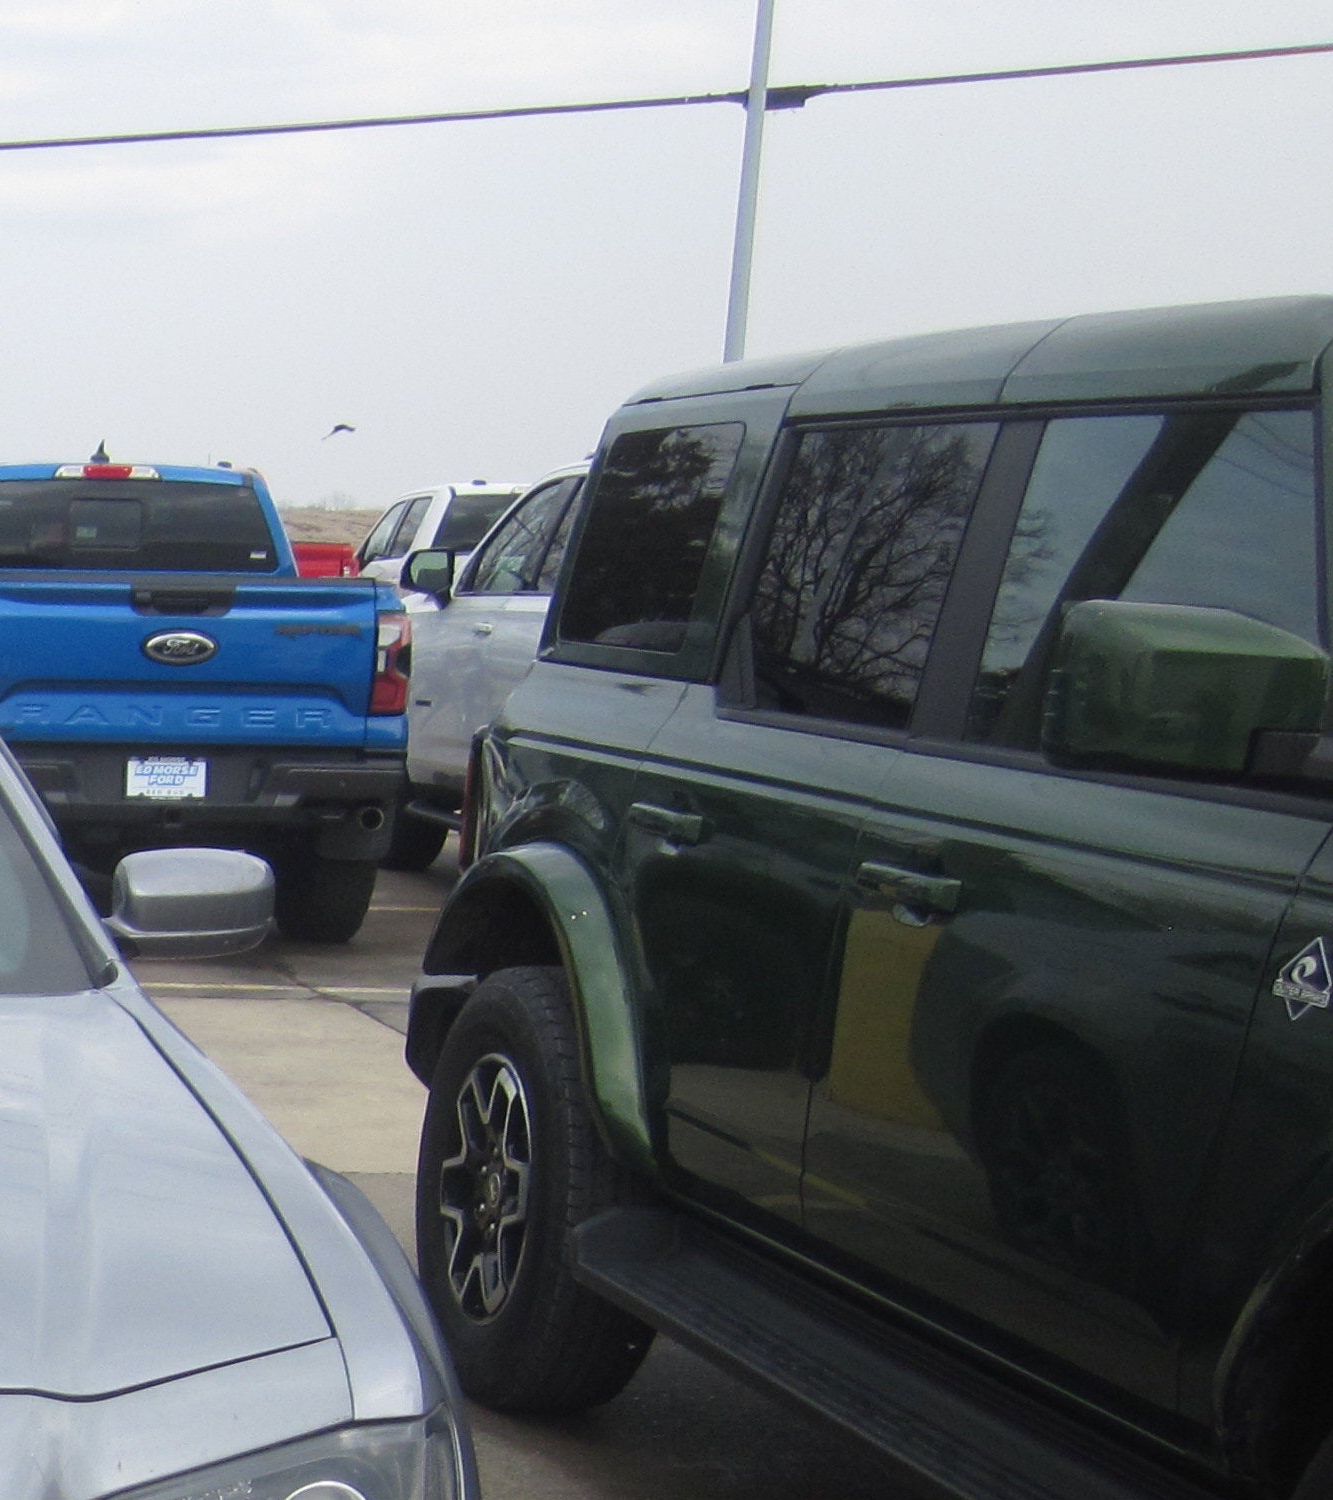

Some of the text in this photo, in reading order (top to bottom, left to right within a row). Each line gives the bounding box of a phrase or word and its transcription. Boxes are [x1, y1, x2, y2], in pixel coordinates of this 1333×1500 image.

[163, 638, 201, 656] Ford
[13, 702, 332, 729] RANGER
[153, 765, 198, 775] MORSE
[149, 775, 185, 785] FORD
